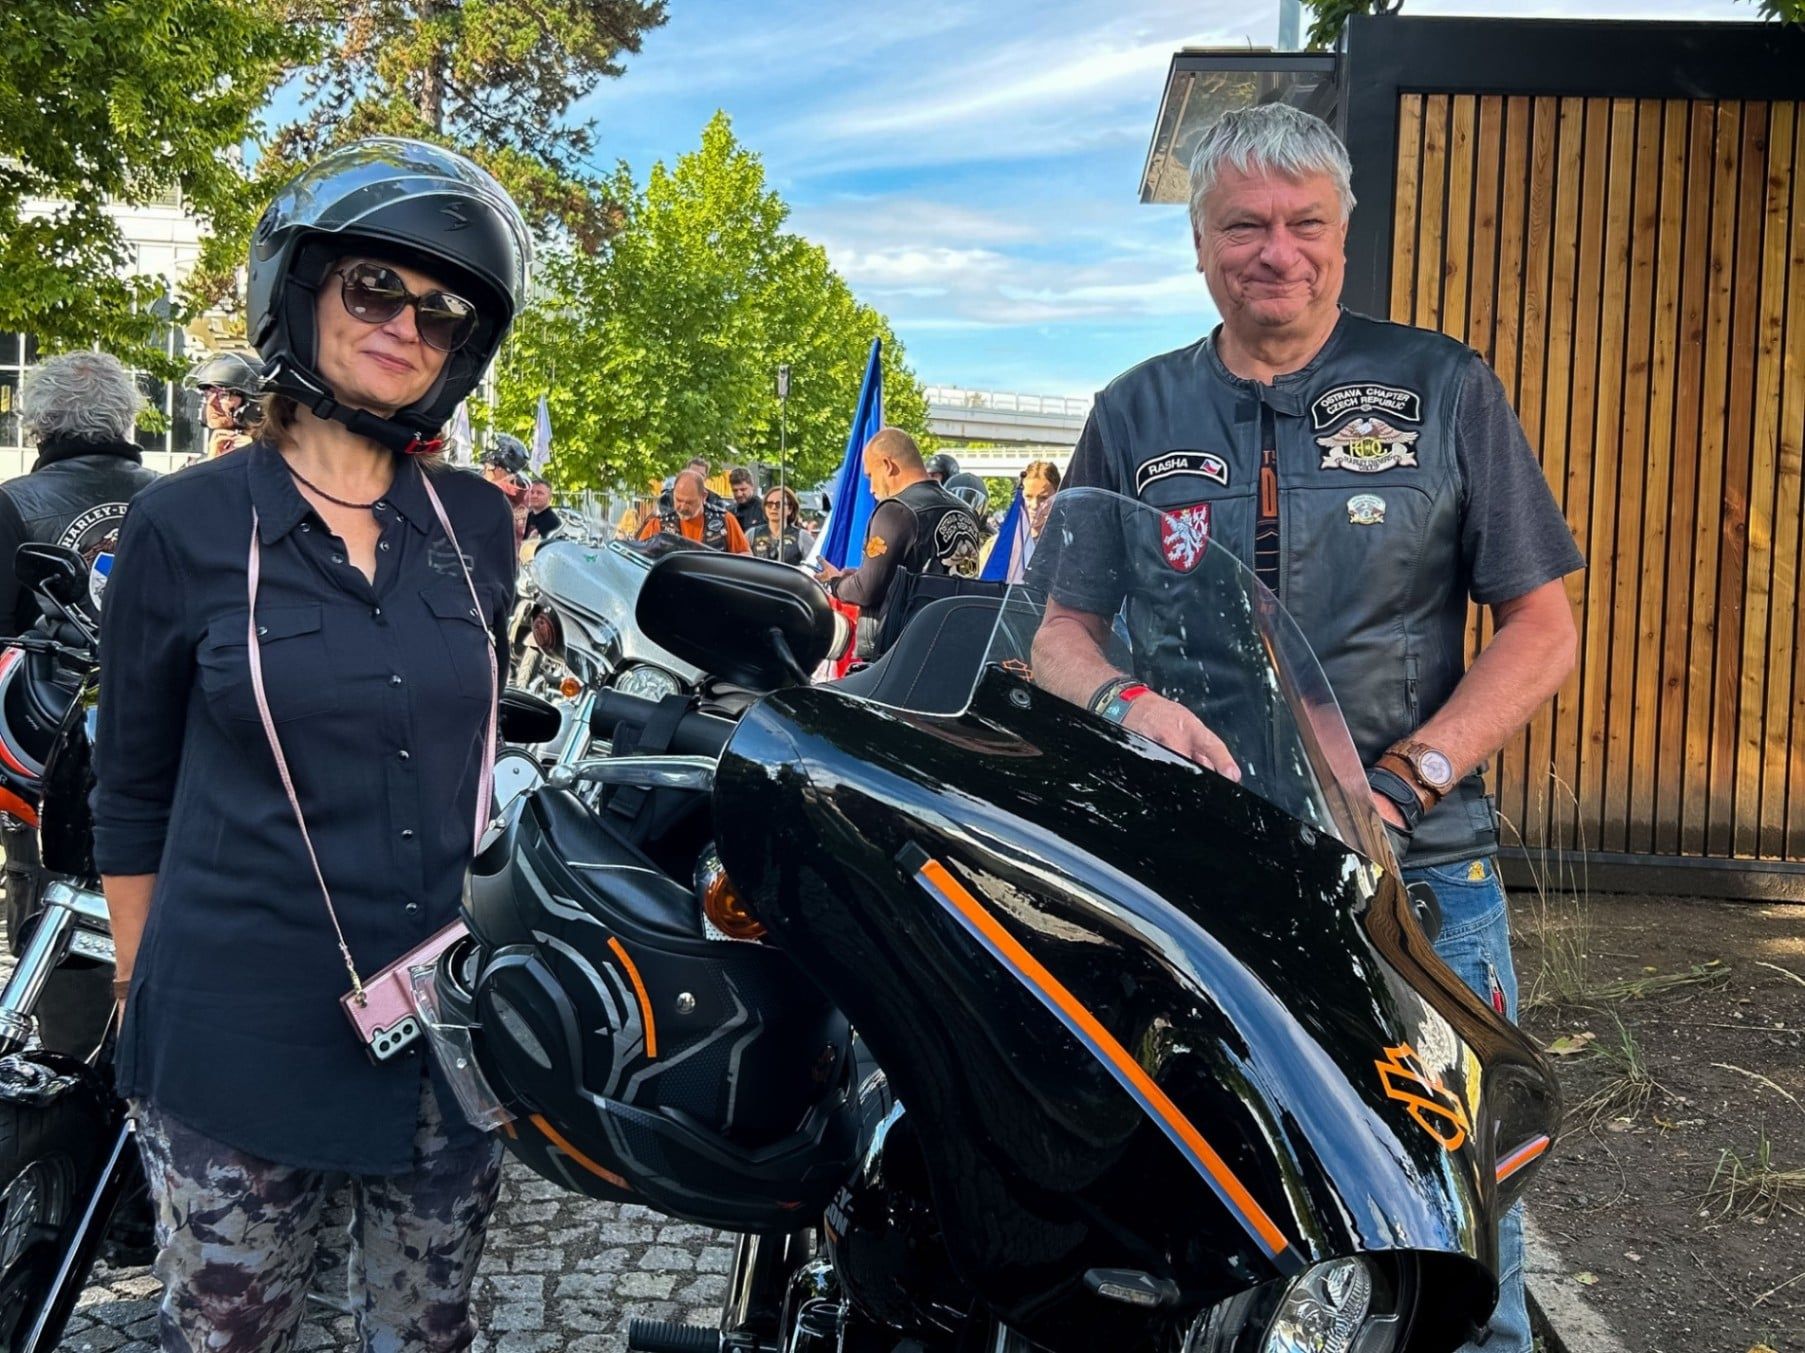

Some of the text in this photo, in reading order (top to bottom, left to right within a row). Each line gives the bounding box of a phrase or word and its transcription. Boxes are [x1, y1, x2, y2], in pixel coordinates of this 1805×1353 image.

[1320, 387, 1410, 407] OSTRAVA CHAPTER
[1326, 396, 1406, 415] CZECH REPUBLIC
[1147, 457, 1189, 475] RASHA
